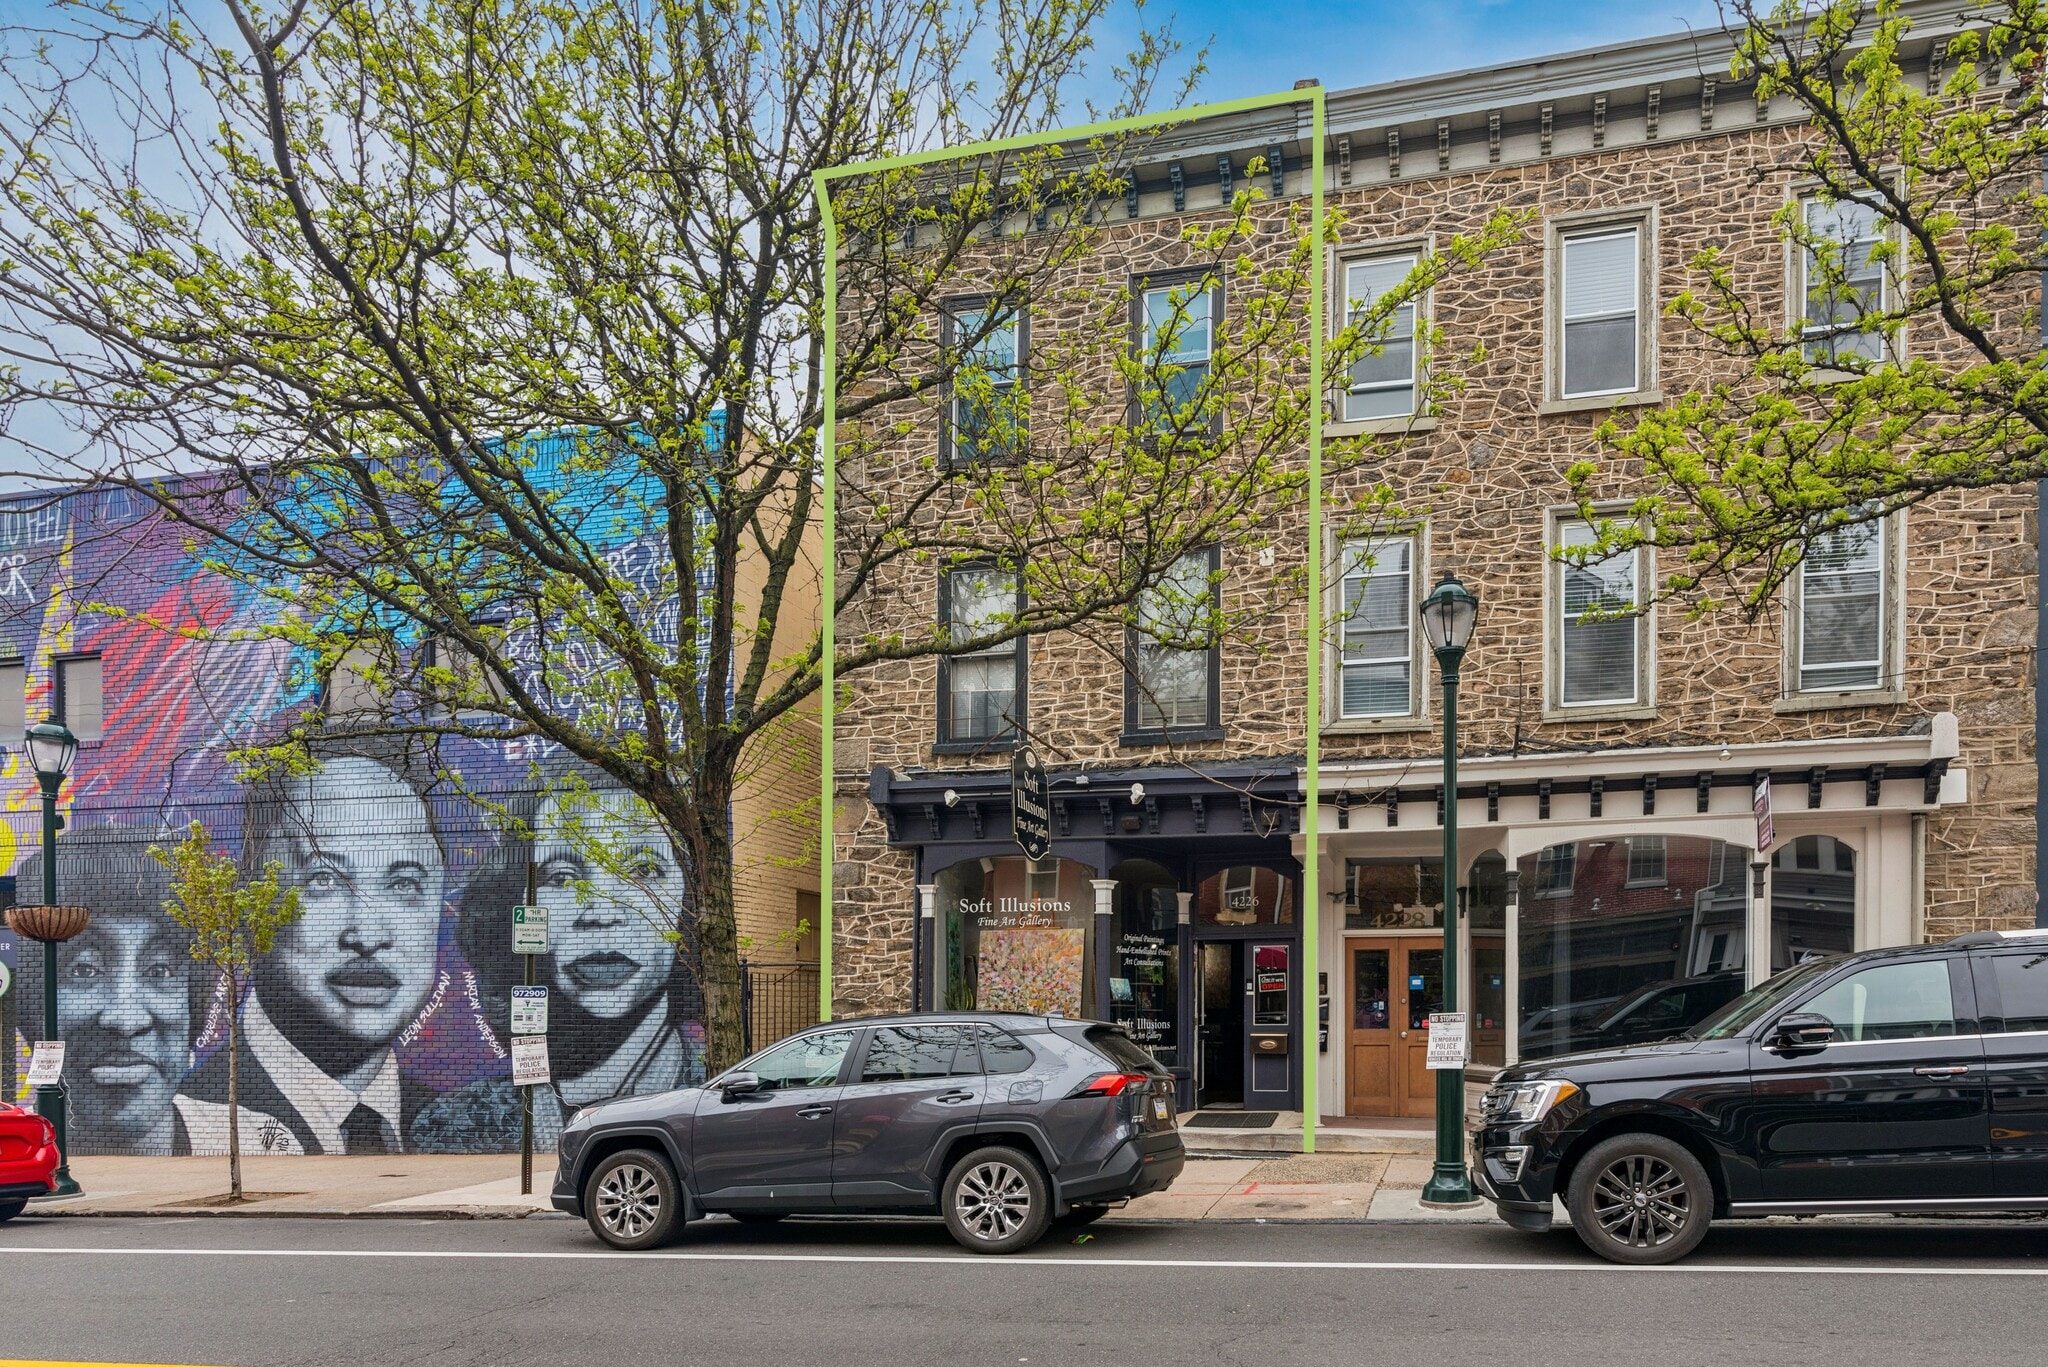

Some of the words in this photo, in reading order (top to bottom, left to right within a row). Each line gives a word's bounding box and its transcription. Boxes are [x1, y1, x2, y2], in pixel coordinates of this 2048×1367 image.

[26, 500, 64, 545] FEEL
[1024, 770, 1039, 794] Soft
[1017, 789, 1047, 820] Illusions
[1016, 816, 1027, 829] Fine
[1026, 820, 1035, 833] Art
[1034, 823, 1048, 842] Gallery
[960, 898, 992, 913] Soft
[1000, 897, 1071, 913] Illusions
[1232, 896, 1259, 907] 4226
[516, 909, 523, 921] 2
[978, 916, 998, 926] Fine
[999, 916, 1016, 927] Art
[1018, 915, 1052, 928] Gallery
[1370, 912, 1425, 929] 4228
[463, 971, 480, 1010] MARIAN
[474, 1014, 507, 1059] ANDERSON
[1440, 1014, 1465, 1022] STOPPING
[1137, 1017, 1170, 1030] Illusions
[399, 1019, 422, 1047] LEON
[1146, 1031, 1162, 1041] Gallery
[520, 1061, 541, 1069] POLICE
